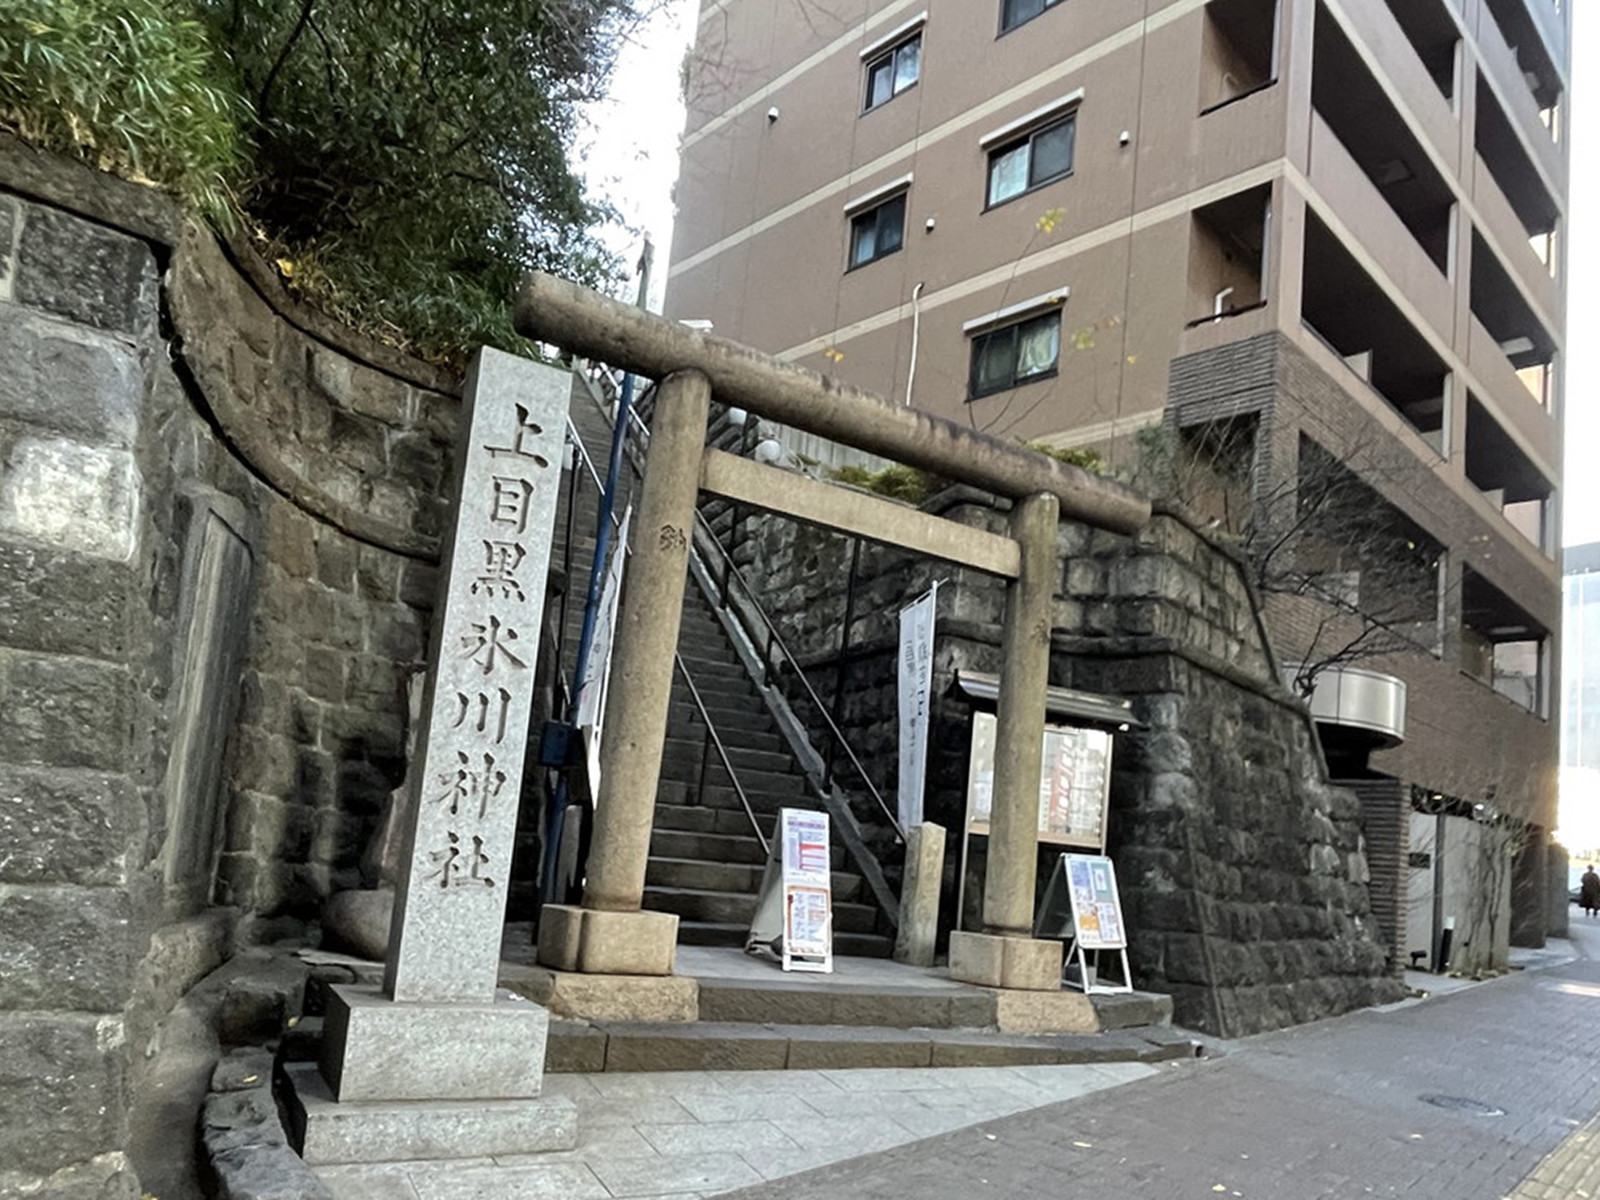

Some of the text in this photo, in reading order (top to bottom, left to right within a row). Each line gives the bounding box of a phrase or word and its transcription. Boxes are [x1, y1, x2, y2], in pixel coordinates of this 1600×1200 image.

[423, 402, 549, 889] 上目黒氷川神社
